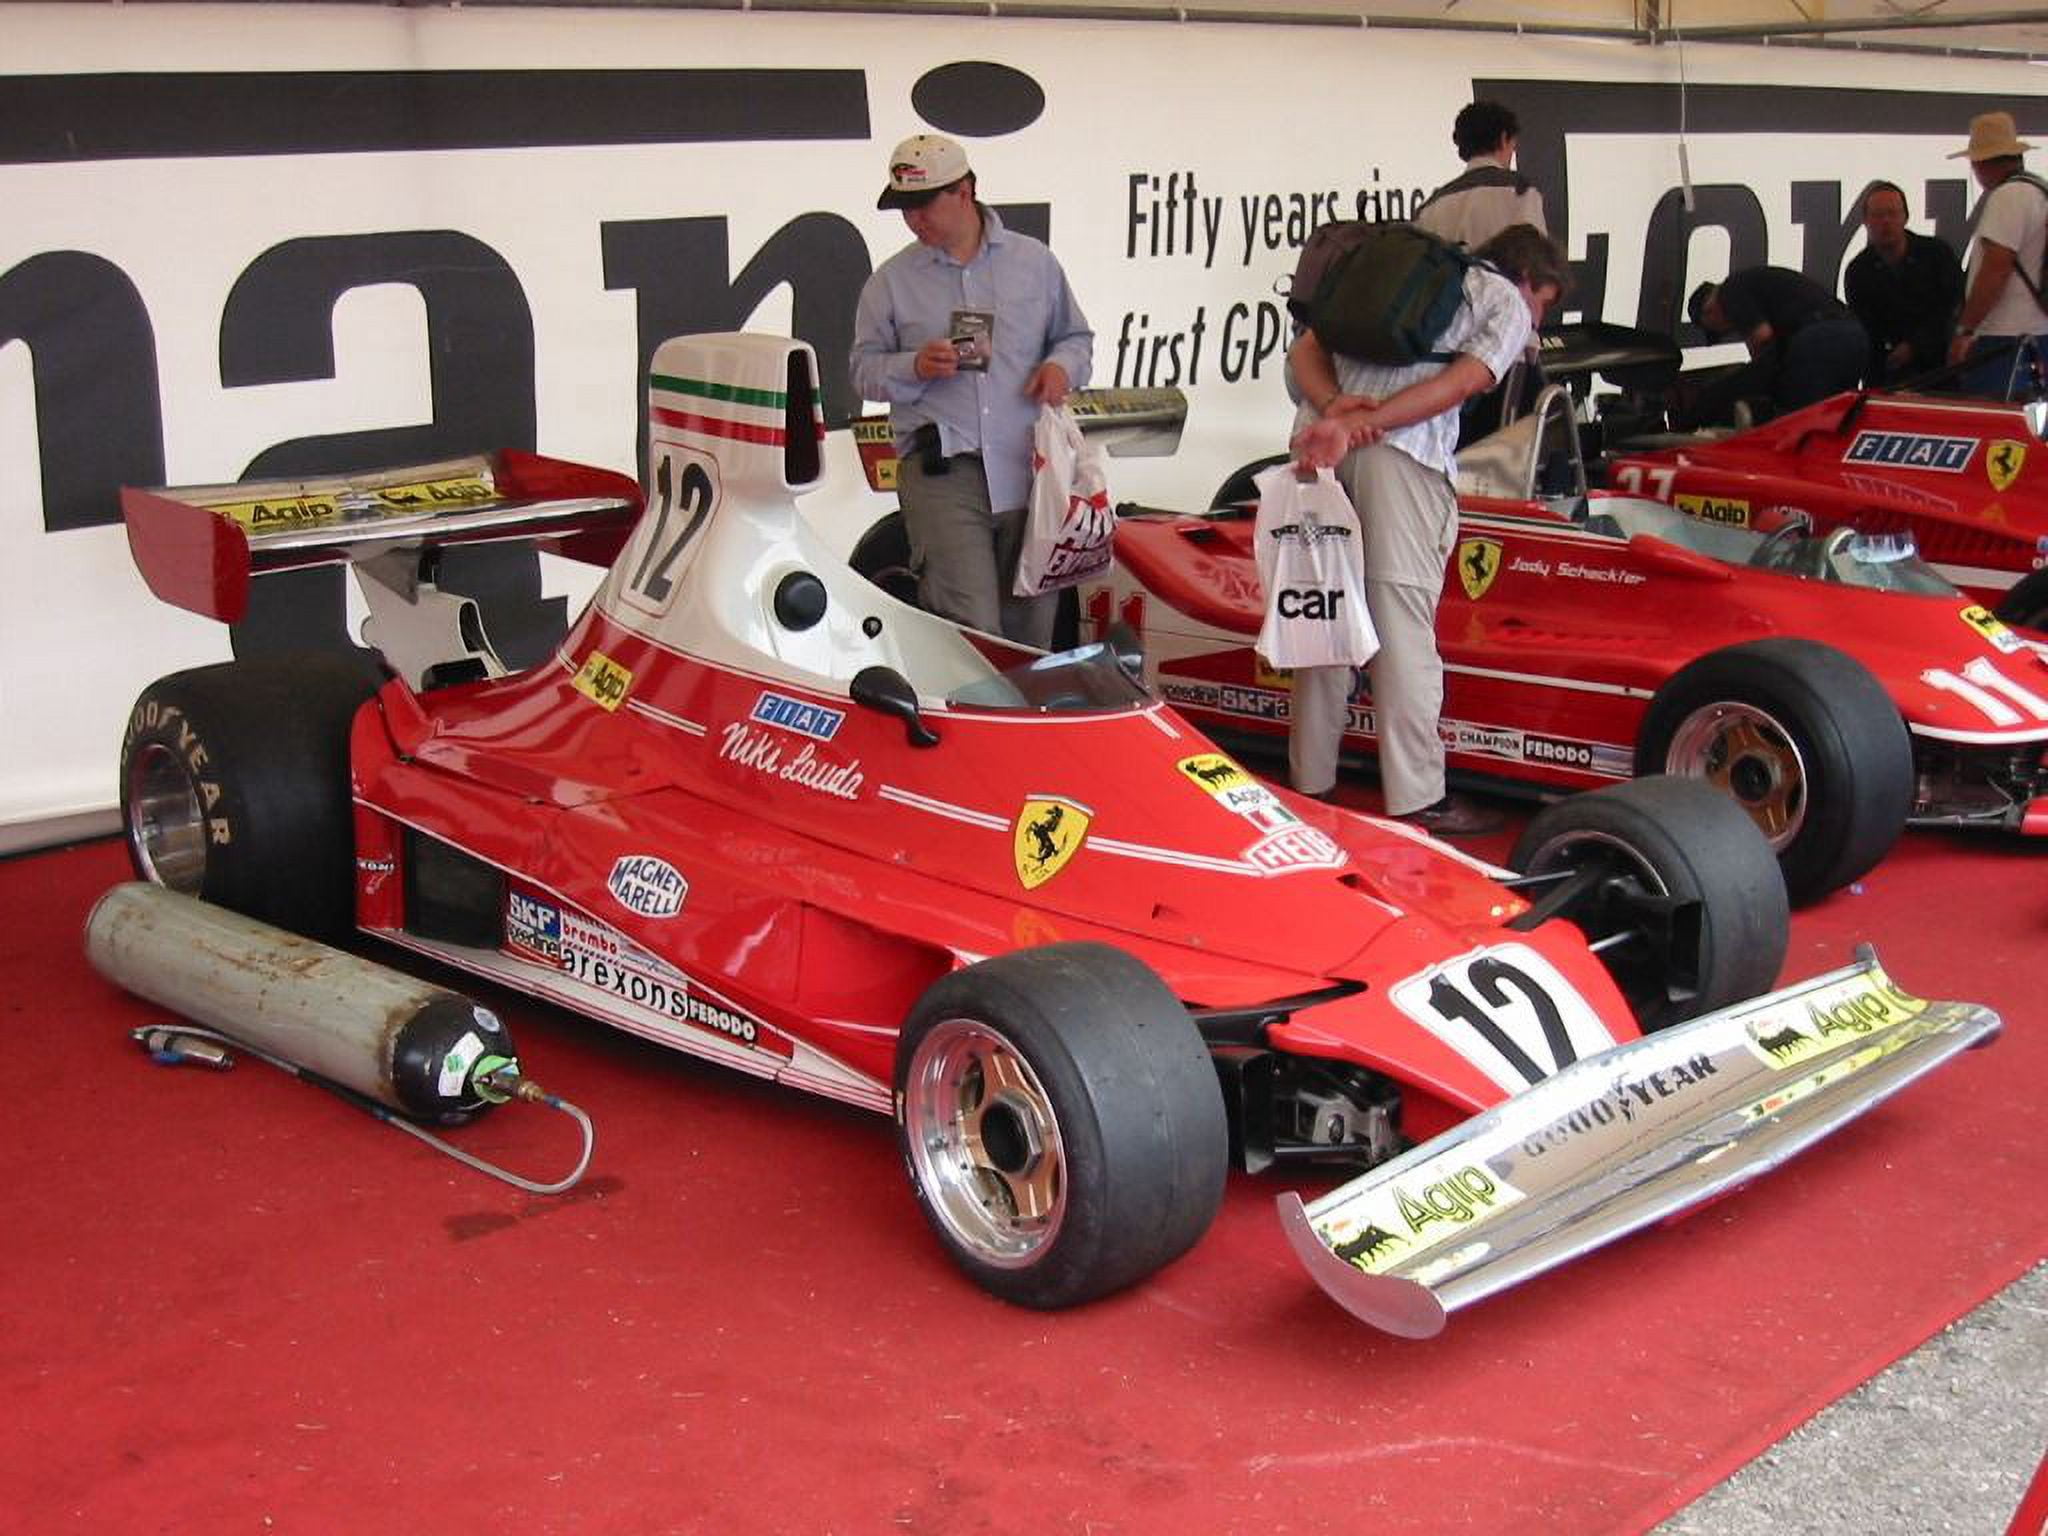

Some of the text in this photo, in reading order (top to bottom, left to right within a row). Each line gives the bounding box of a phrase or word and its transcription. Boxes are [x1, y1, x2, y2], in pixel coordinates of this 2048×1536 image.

[1127, 171, 1222, 268] Fifty
[1241, 189, 1339, 266] years
[1114, 306, 1205, 388] first
[1854, 434, 1971, 471] FIAT
[252, 500, 333, 524] Agip
[630, 455, 714, 602] 12
[1701, 499, 1746, 524] Agip
[1508, 556, 1550, 577] Jody
[1277, 588, 1345, 621] car
[1919, 656, 2048, 728] 11
[757, 697, 838, 735] FIAT
[719, 722, 865, 800] Niki Lauda
[1525, 739, 1591, 764] FERODO
[510, 892, 556, 931] SKF
[563, 920, 618, 955] brembo
[563, 947, 686, 1018] arexons
[690, 998, 756, 1042] FERODO
[1428, 956, 1578, 1087] 12
[1807, 991, 1890, 1039] Agip
[1393, 1166, 1497, 1234] Agip
